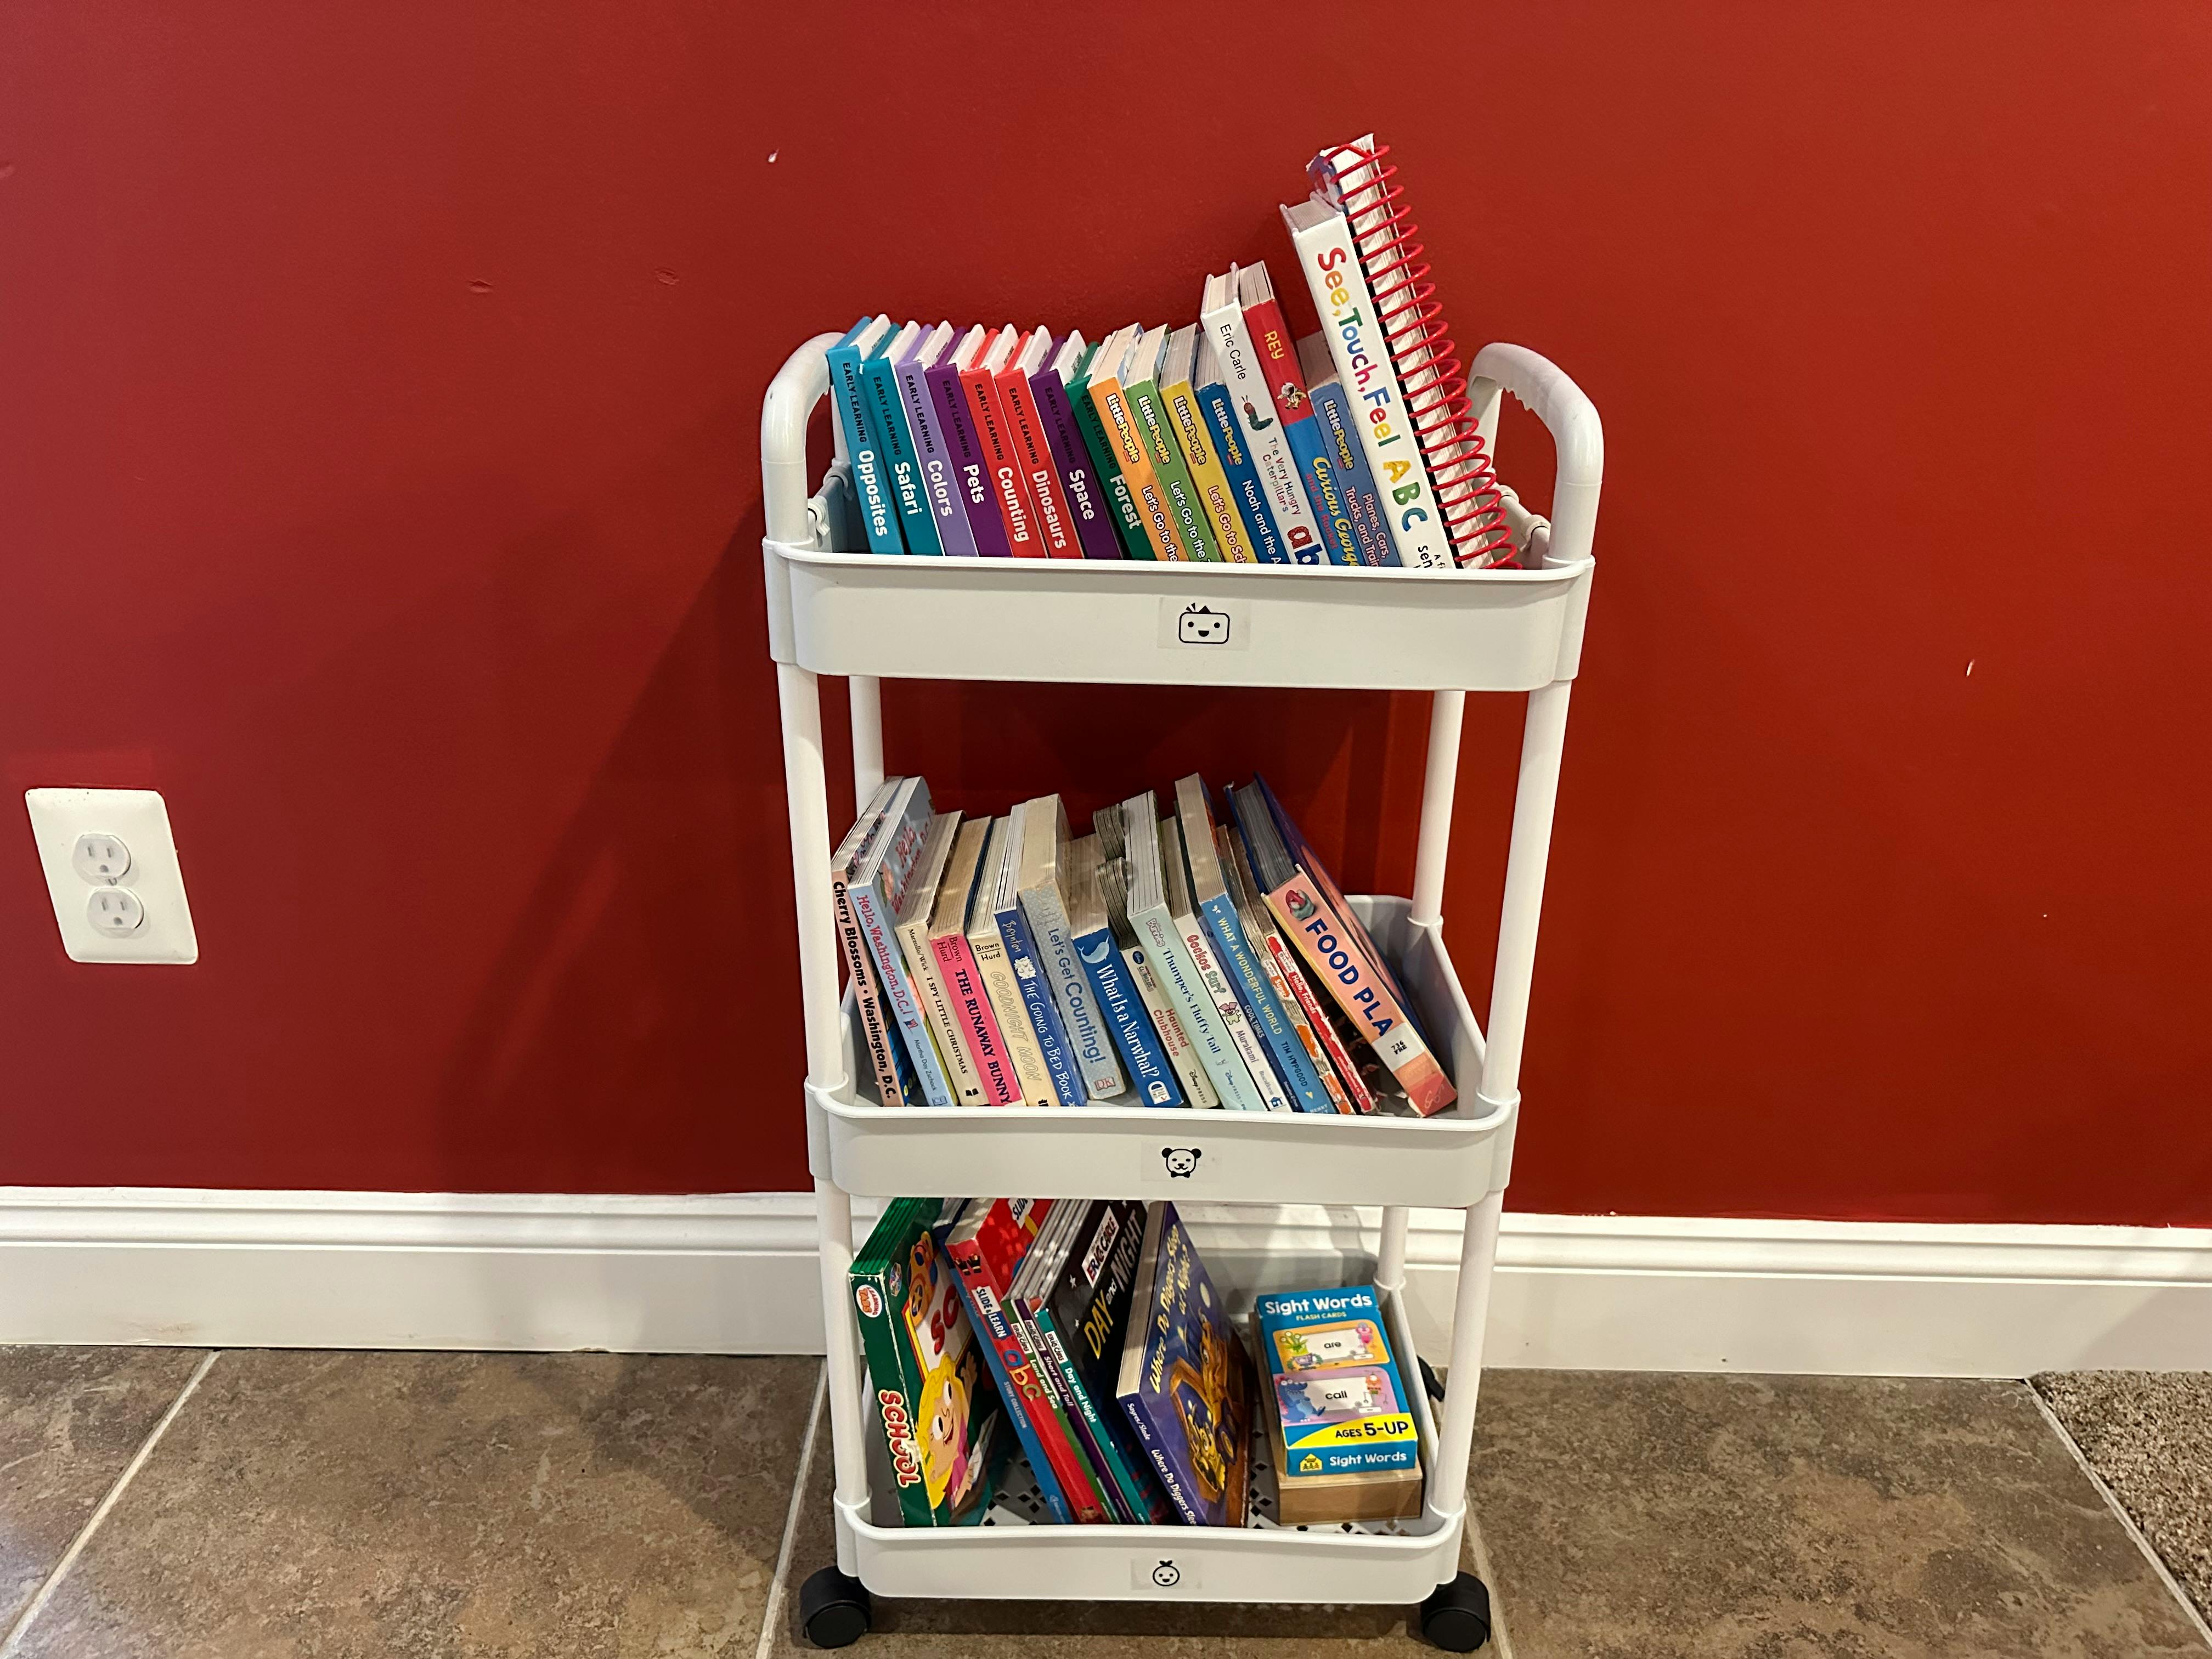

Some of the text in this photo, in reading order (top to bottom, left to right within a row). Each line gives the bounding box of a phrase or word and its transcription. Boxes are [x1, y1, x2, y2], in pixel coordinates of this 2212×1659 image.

[1220, 324, 1246, 380] Eric Carle
[1264, 330, 1284, 359] REY
[843, 363, 887, 536] EARLY LEARNING Opposites
[873, 376, 922, 515] EARLY LEARNING Safari
[906, 375, 952, 516] EARLY LEARNING Colors
[943, 380, 984, 504] EARLY LEARNING Pets
[975, 383, 990, 412] EARLY
[985, 414, 1004, 461] LEARNING
[998, 467, 1029, 543] Counting
[1008, 387, 1024, 416] EARLY
[1019, 418, 1039, 465] LEARNING
[1032, 470, 1066, 549] Dinosaurs
[1045, 387, 1094, 520] EARLY LEARNING Space
[1081, 394, 1142, 529] EARLY LEARNING Forest
[1363, 387, 1401, 447] Feel
[1383, 460, 1428, 532] ABC
[1263, 454, 1288, 512] Caterpillars
[1268, 439, 1301, 515] The Very Hungry
[1313, 456, 1342, 517] Curious
[1142, 485, 1178, 561] Let's Go to the
[1170, 480, 1206, 558] Let's Go to the
[1207, 485, 1237, 545] Let's Go to
[1242, 479, 1276, 555] Noah and the
[1345, 486, 1372, 544] Trucks, and
[1363, 493, 1390, 558] Planes, Cars,
[856, 895, 913, 1015] Hello, Washington, D.C.!
[937, 941, 951, 962] Hurd
[949, 936, 962, 962] Brown
[975, 943, 1000, 952] Brown
[981, 951, 1001, 961] Hurd
[1048, 928, 1065, 956] Let's
[1059, 957, 1075, 979] Get
[1187, 934, 1211, 971] Geckos
[833, 881, 896, 1099] Cherry Blossoms Washington, D.C.
[1097, 963, 1123, 1001] What
[1163, 947, 1221, 1054] Thumper's Fluffy Tail
[1218, 917, 1236, 942] WHAT
[1235, 952, 1266, 1005] WONDERFUL
[1262, 1004, 1282, 1035] WORLD
[1302, 992, 1317, 1014] Friends
[1305, 918, 1394, 1036] FOOD PLA
[929, 983, 968, 1074] SPY LITTLE CHRISTMAS
[990, 971, 1042, 1081] GOODNIGHT MOON
[1065, 981, 1106, 1064] Counting!
[1111, 998, 1128, 1013] Is
[1117, 1013, 1129, 1023] a
[1154, 1009, 1179, 1057] Clubhouse
[1165, 1008, 1189, 1048] Haunted
[1244, 1005, 1254, 1020] COOL
[955, 968, 1013, 1104] THE RUNAWAY BUNNY
[1023, 980, 1073, 1099] THE GOING TO BED BOOK
[1120, 1020, 1160, 1077] Narwhal?
[1235, 1030, 1260, 1063] Murakami
[1280, 1041, 1291, 1054] TIM
[1391, 1040, 1404, 1050] 736
[1083, 1209, 1142, 1359] DAY and NIGHT
[1086, 1255, 1105, 1283] ERIC
[1160, 1259, 1175, 1313] Diggers
[858, 1288, 872, 1314] TABS
[976, 1288, 1007, 1338] SLIDE LEARN
[1157, 1313, 1170, 1338] Do
[1265, 1294, 1373, 1315] Sight Words
[1004, 1350, 1041, 1401] abc
[1030, 1359, 1058, 1409] Land and Sea
[1044, 1356, 1074, 1407] Short and Tall
[1149, 1336, 1166, 1394] Where
[1004, 1381, 1027, 1428] STORY COLLECTION
[1065, 1367, 1097, 1423] Day and Night
[1325, 1391, 1347, 1400] call
[878, 1389, 921, 1488] SCHOOL
[1335, 1421, 1409, 1438] AGES 5-UP
[1151, 1449, 1189, 1511] Where Do Diggers
[1329, 1455, 1361, 1466] Sight
[1364, 1451, 1407, 1464] Words
